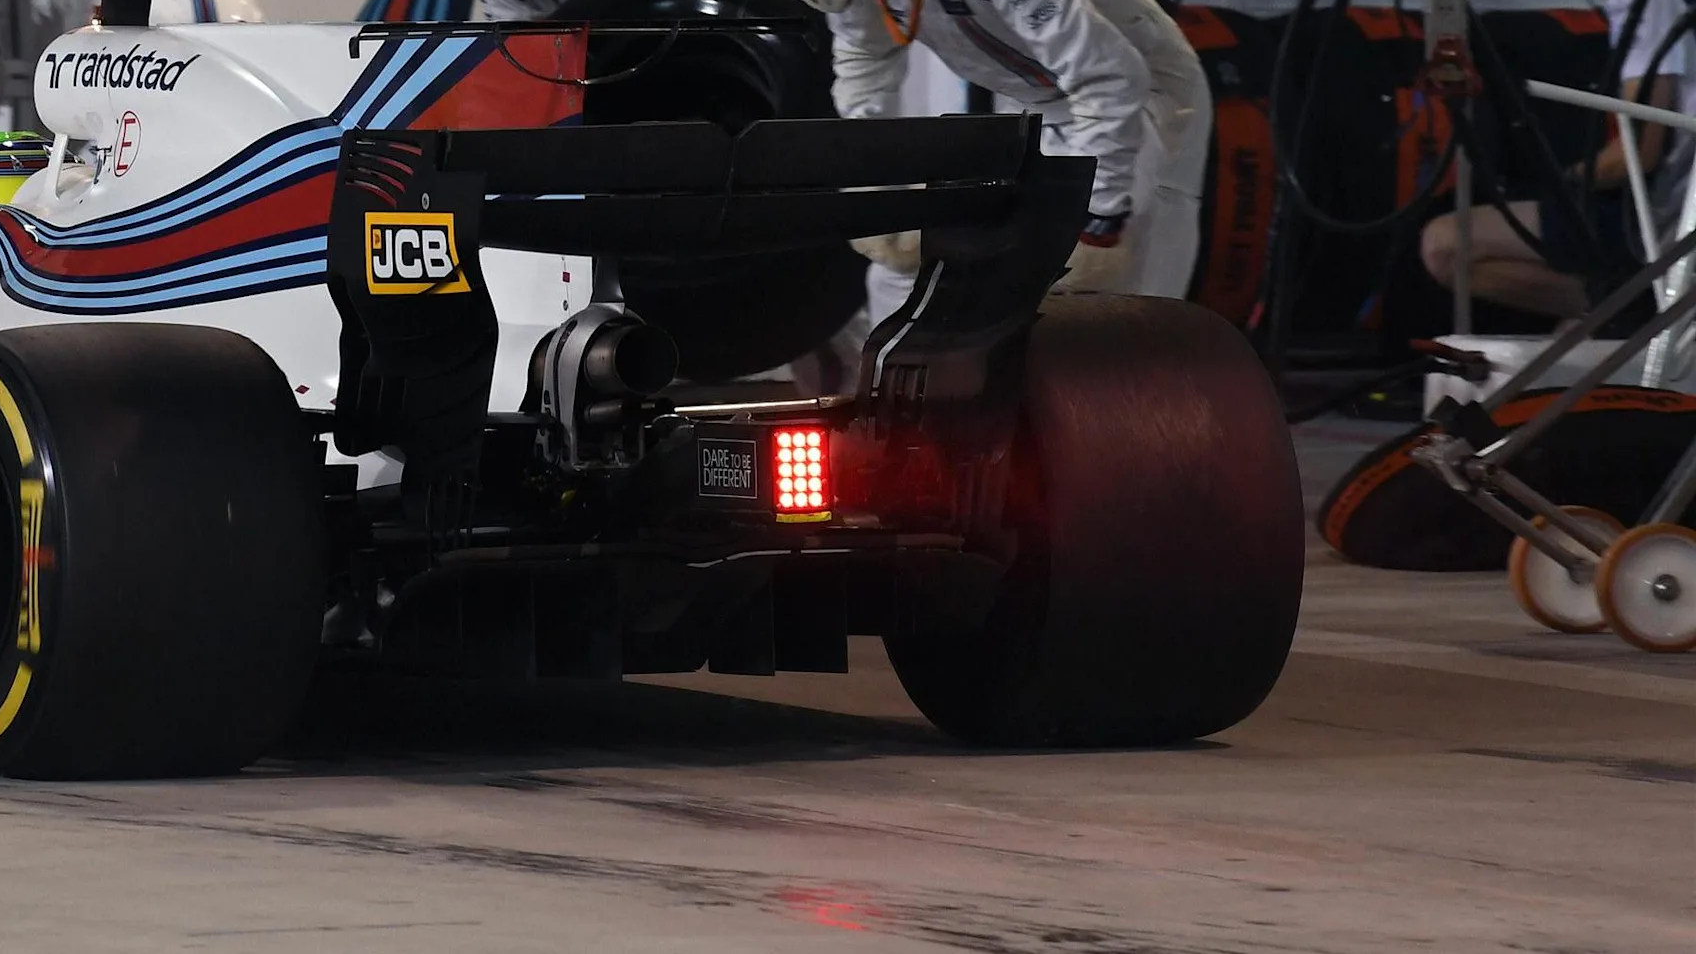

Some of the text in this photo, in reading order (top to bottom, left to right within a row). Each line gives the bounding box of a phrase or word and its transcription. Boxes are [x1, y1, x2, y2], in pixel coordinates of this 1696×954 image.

[72, 43, 202, 92] randstad
[115, 117, 137, 171] E
[372, 228, 454, 279] JCB
[703, 448, 752, 469] DARE TO BE
[703, 467, 752, 489] DIFFERENT
